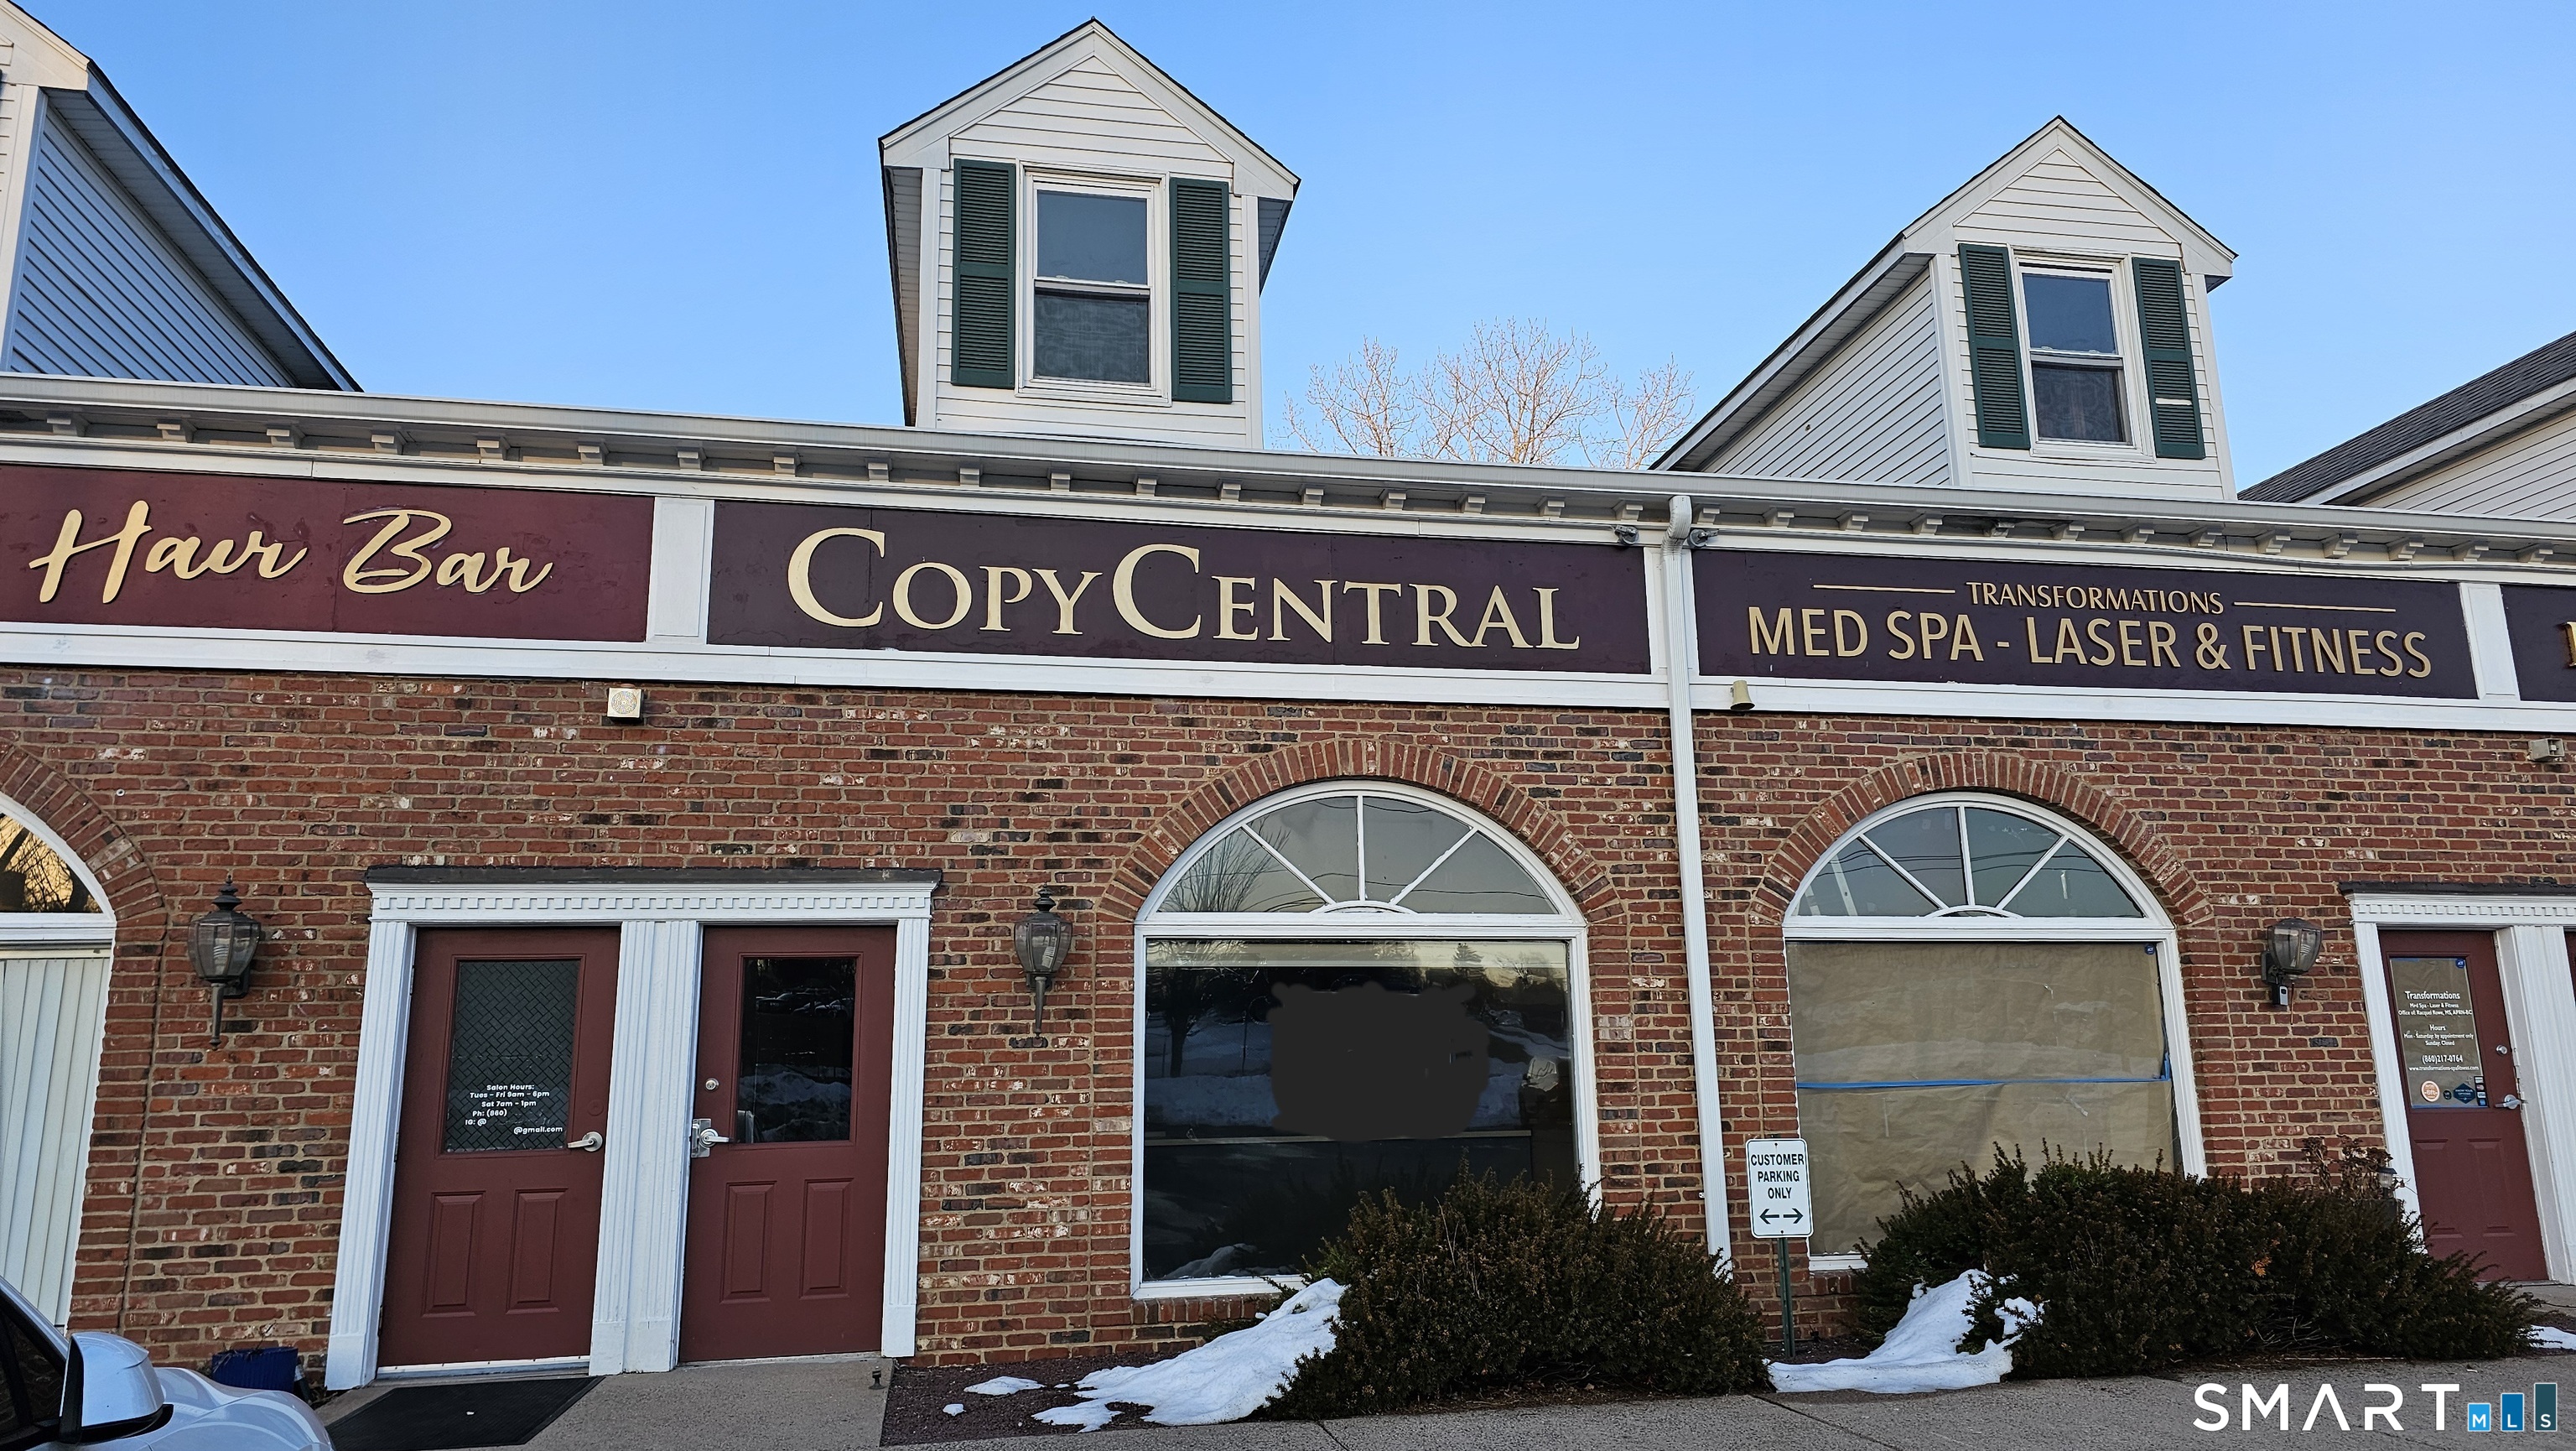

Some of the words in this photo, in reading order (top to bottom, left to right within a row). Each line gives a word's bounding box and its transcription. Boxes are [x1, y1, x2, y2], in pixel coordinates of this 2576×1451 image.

[29, 500, 307, 604] Hair
[342, 508, 554, 593] Bar
[1966, 581, 2224, 615] TRANSFORMATIONS
[1748, 606, 1869, 658] MED
[1886, 608, 1985, 663] SPA
[1996, 640, 2011, 650] -
[2025, 616, 2182, 668] LASER
[2194, 621, 2229, 670] &
[2244, 624, 2432, 679] FITNESS
[2404, 991, 2460, 1000] Transformations
[2422, 1054, 2463, 1064] (860)217-0764
[486, 1109, 507, 1117] (860)
[513, 1126, 563, 1135] @gmail.com
[1751, 1153, 1805, 1166] CUSTOMER
[1758, 1170, 1800, 1183] PARKING
[1768, 1187, 1792, 1199] ONLY
